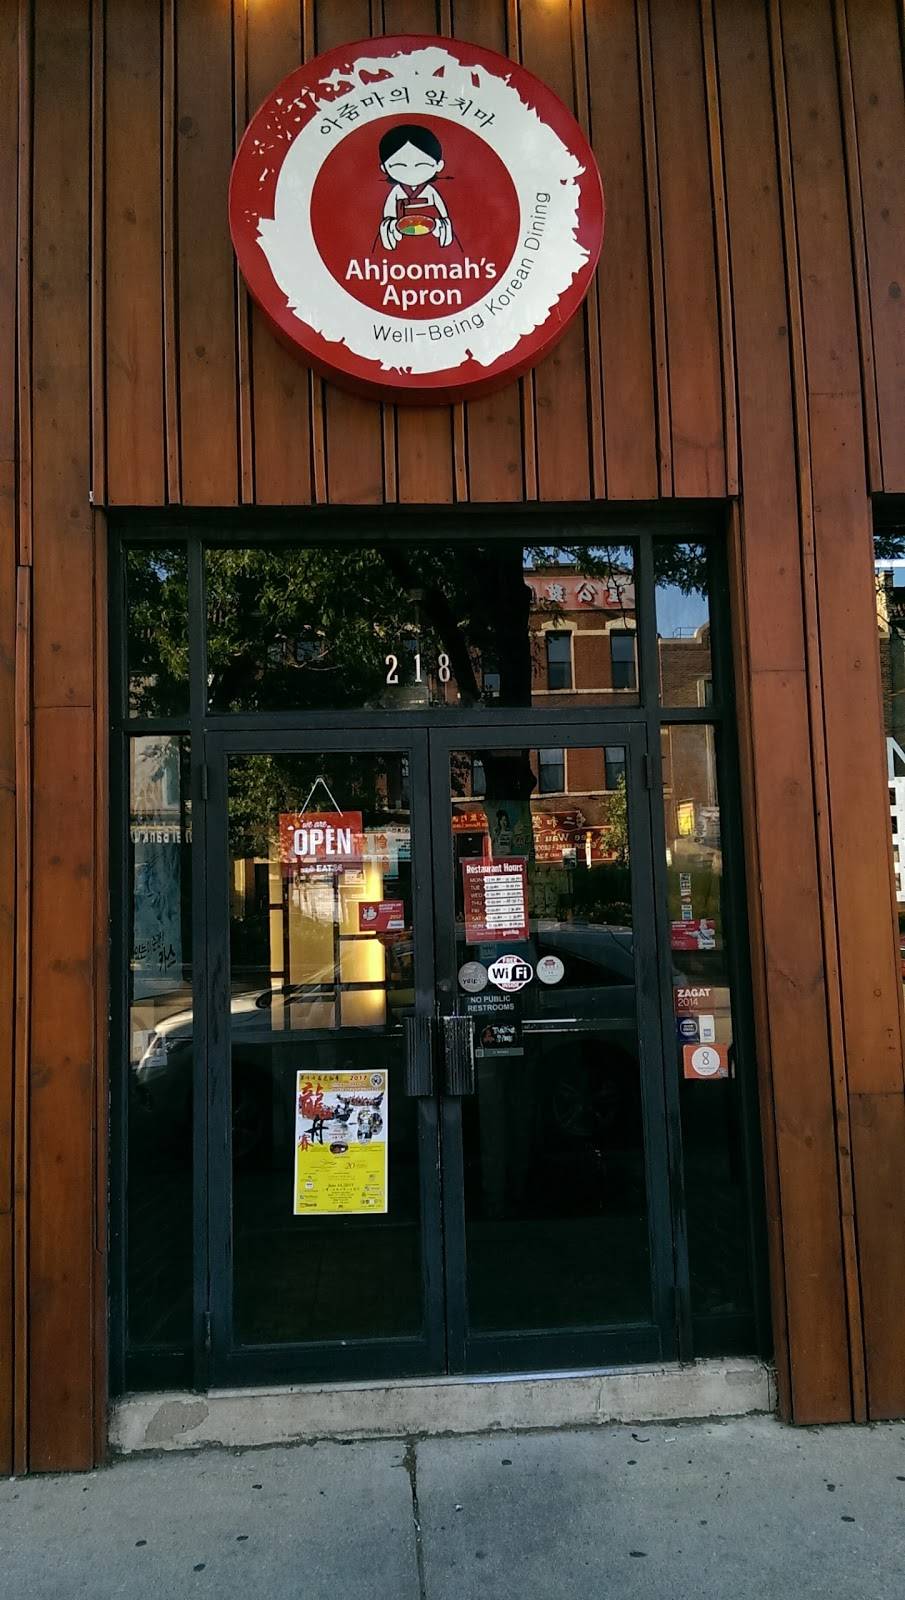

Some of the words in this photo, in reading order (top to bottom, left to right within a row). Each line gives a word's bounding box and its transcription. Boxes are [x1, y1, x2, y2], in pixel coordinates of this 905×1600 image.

[319, 86, 411, 136] 아줌마의
[424, 88, 498, 129] 앞치마
[345, 257, 497, 285] Ahjoomah's
[372, 312, 485, 343] Well-Being
[485, 257, 535, 316] Korean
[523, 191, 551, 252] Dining
[382, 284, 462, 311] Apron
[293, 828, 352, 856] OPEN
[466, 864, 502, 874] Restaurant
[503, 863, 523, 872] Hours
[483, 995, 511, 1003] PUBLIC
[677, 988, 712, 998] ZAGAT
[467, 1003, 515, 1012] RESTROOMS
[677, 998, 699, 1007] 2014
[702, 1051, 710, 1066] 8
